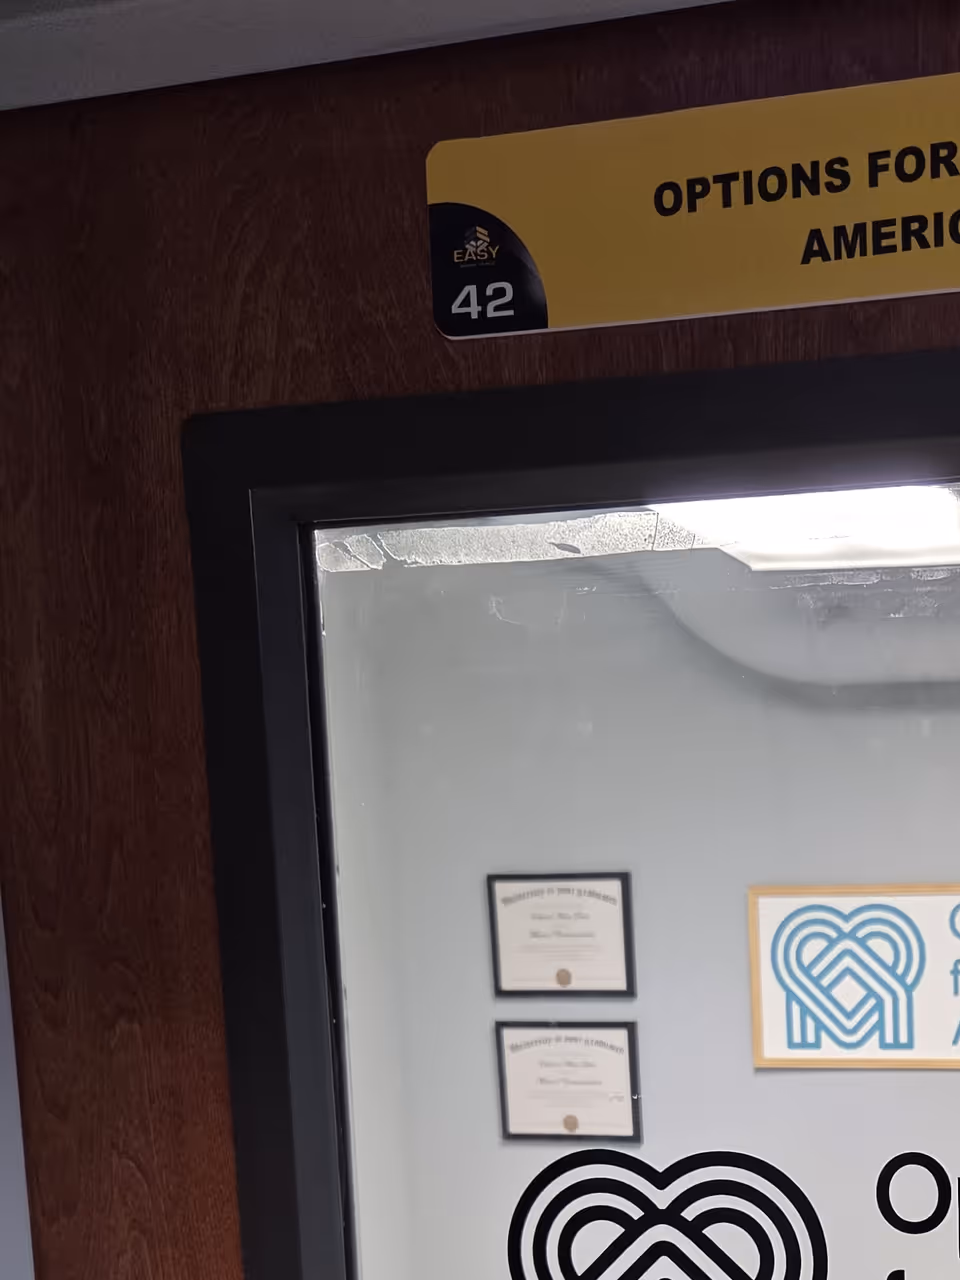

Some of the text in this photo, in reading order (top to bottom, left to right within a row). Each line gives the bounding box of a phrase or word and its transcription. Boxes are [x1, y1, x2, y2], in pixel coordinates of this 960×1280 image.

[653, 157, 851, 217] OPTIONS
[867, 141, 960, 188] FOR
[453, 245, 500, 263] EASY
[451, 281, 515, 319] 42
